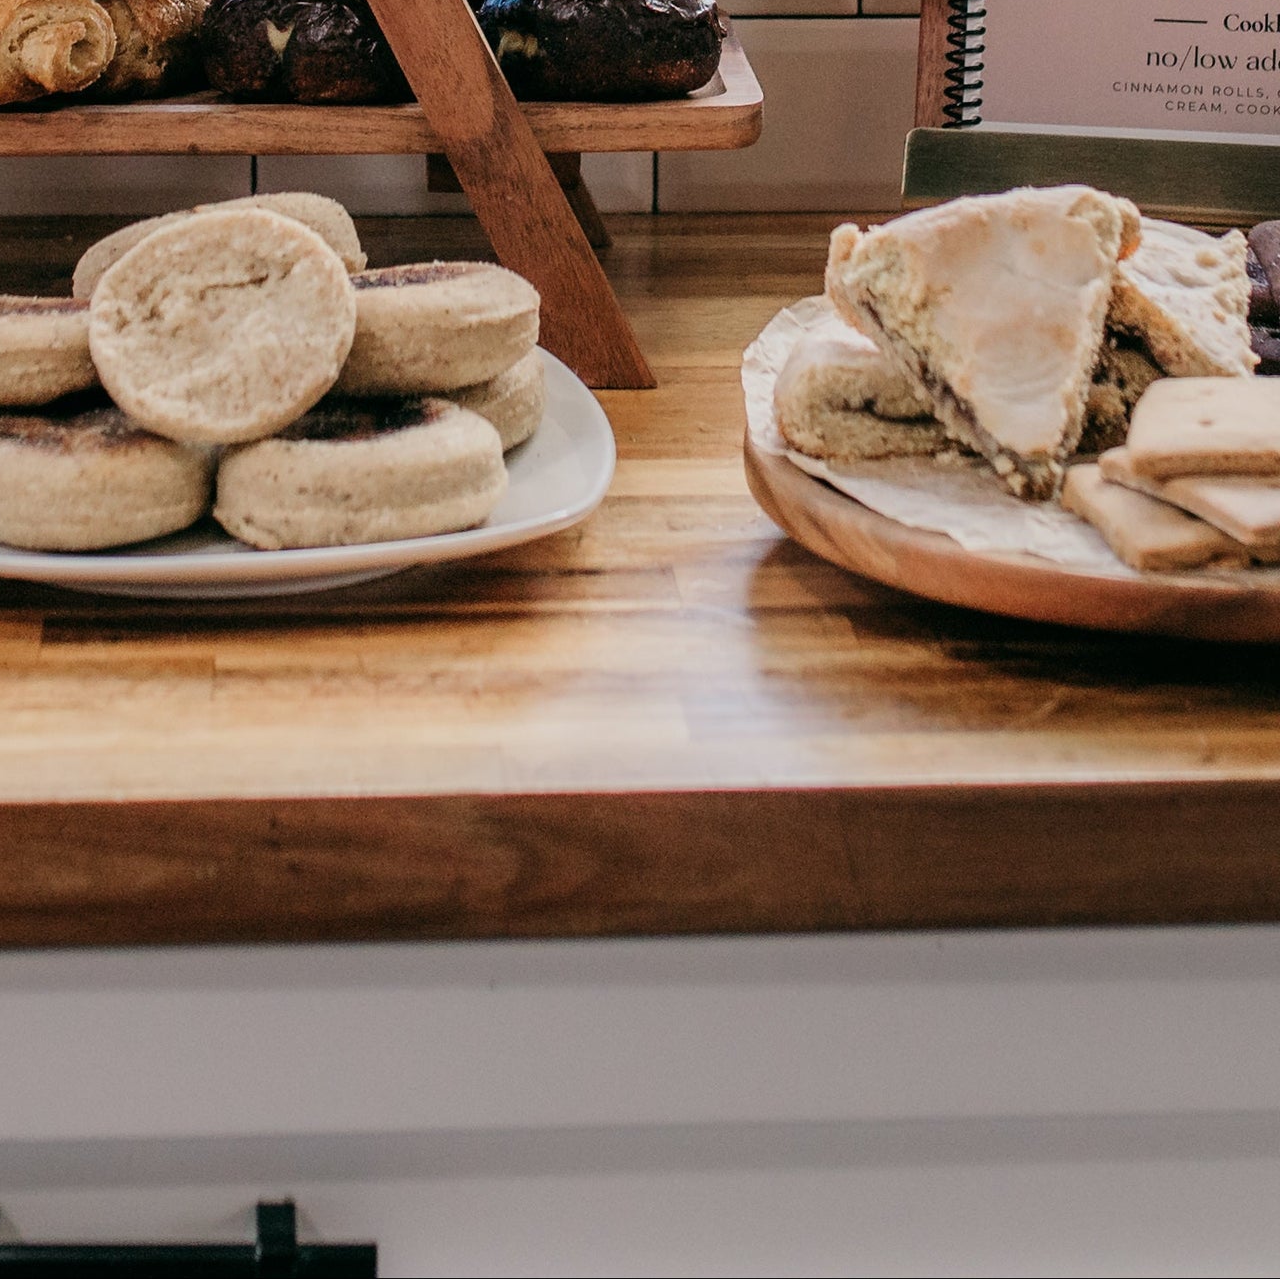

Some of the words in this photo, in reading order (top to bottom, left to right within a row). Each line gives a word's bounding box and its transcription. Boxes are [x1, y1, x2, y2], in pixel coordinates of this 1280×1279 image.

[1146, 45, 1238, 72] no/low
[1113, 81, 1204, 95] CINNAMON
[1212, 85, 1270, 100] ROLLS,
[1165, 100, 1228, 115] CREAM,
